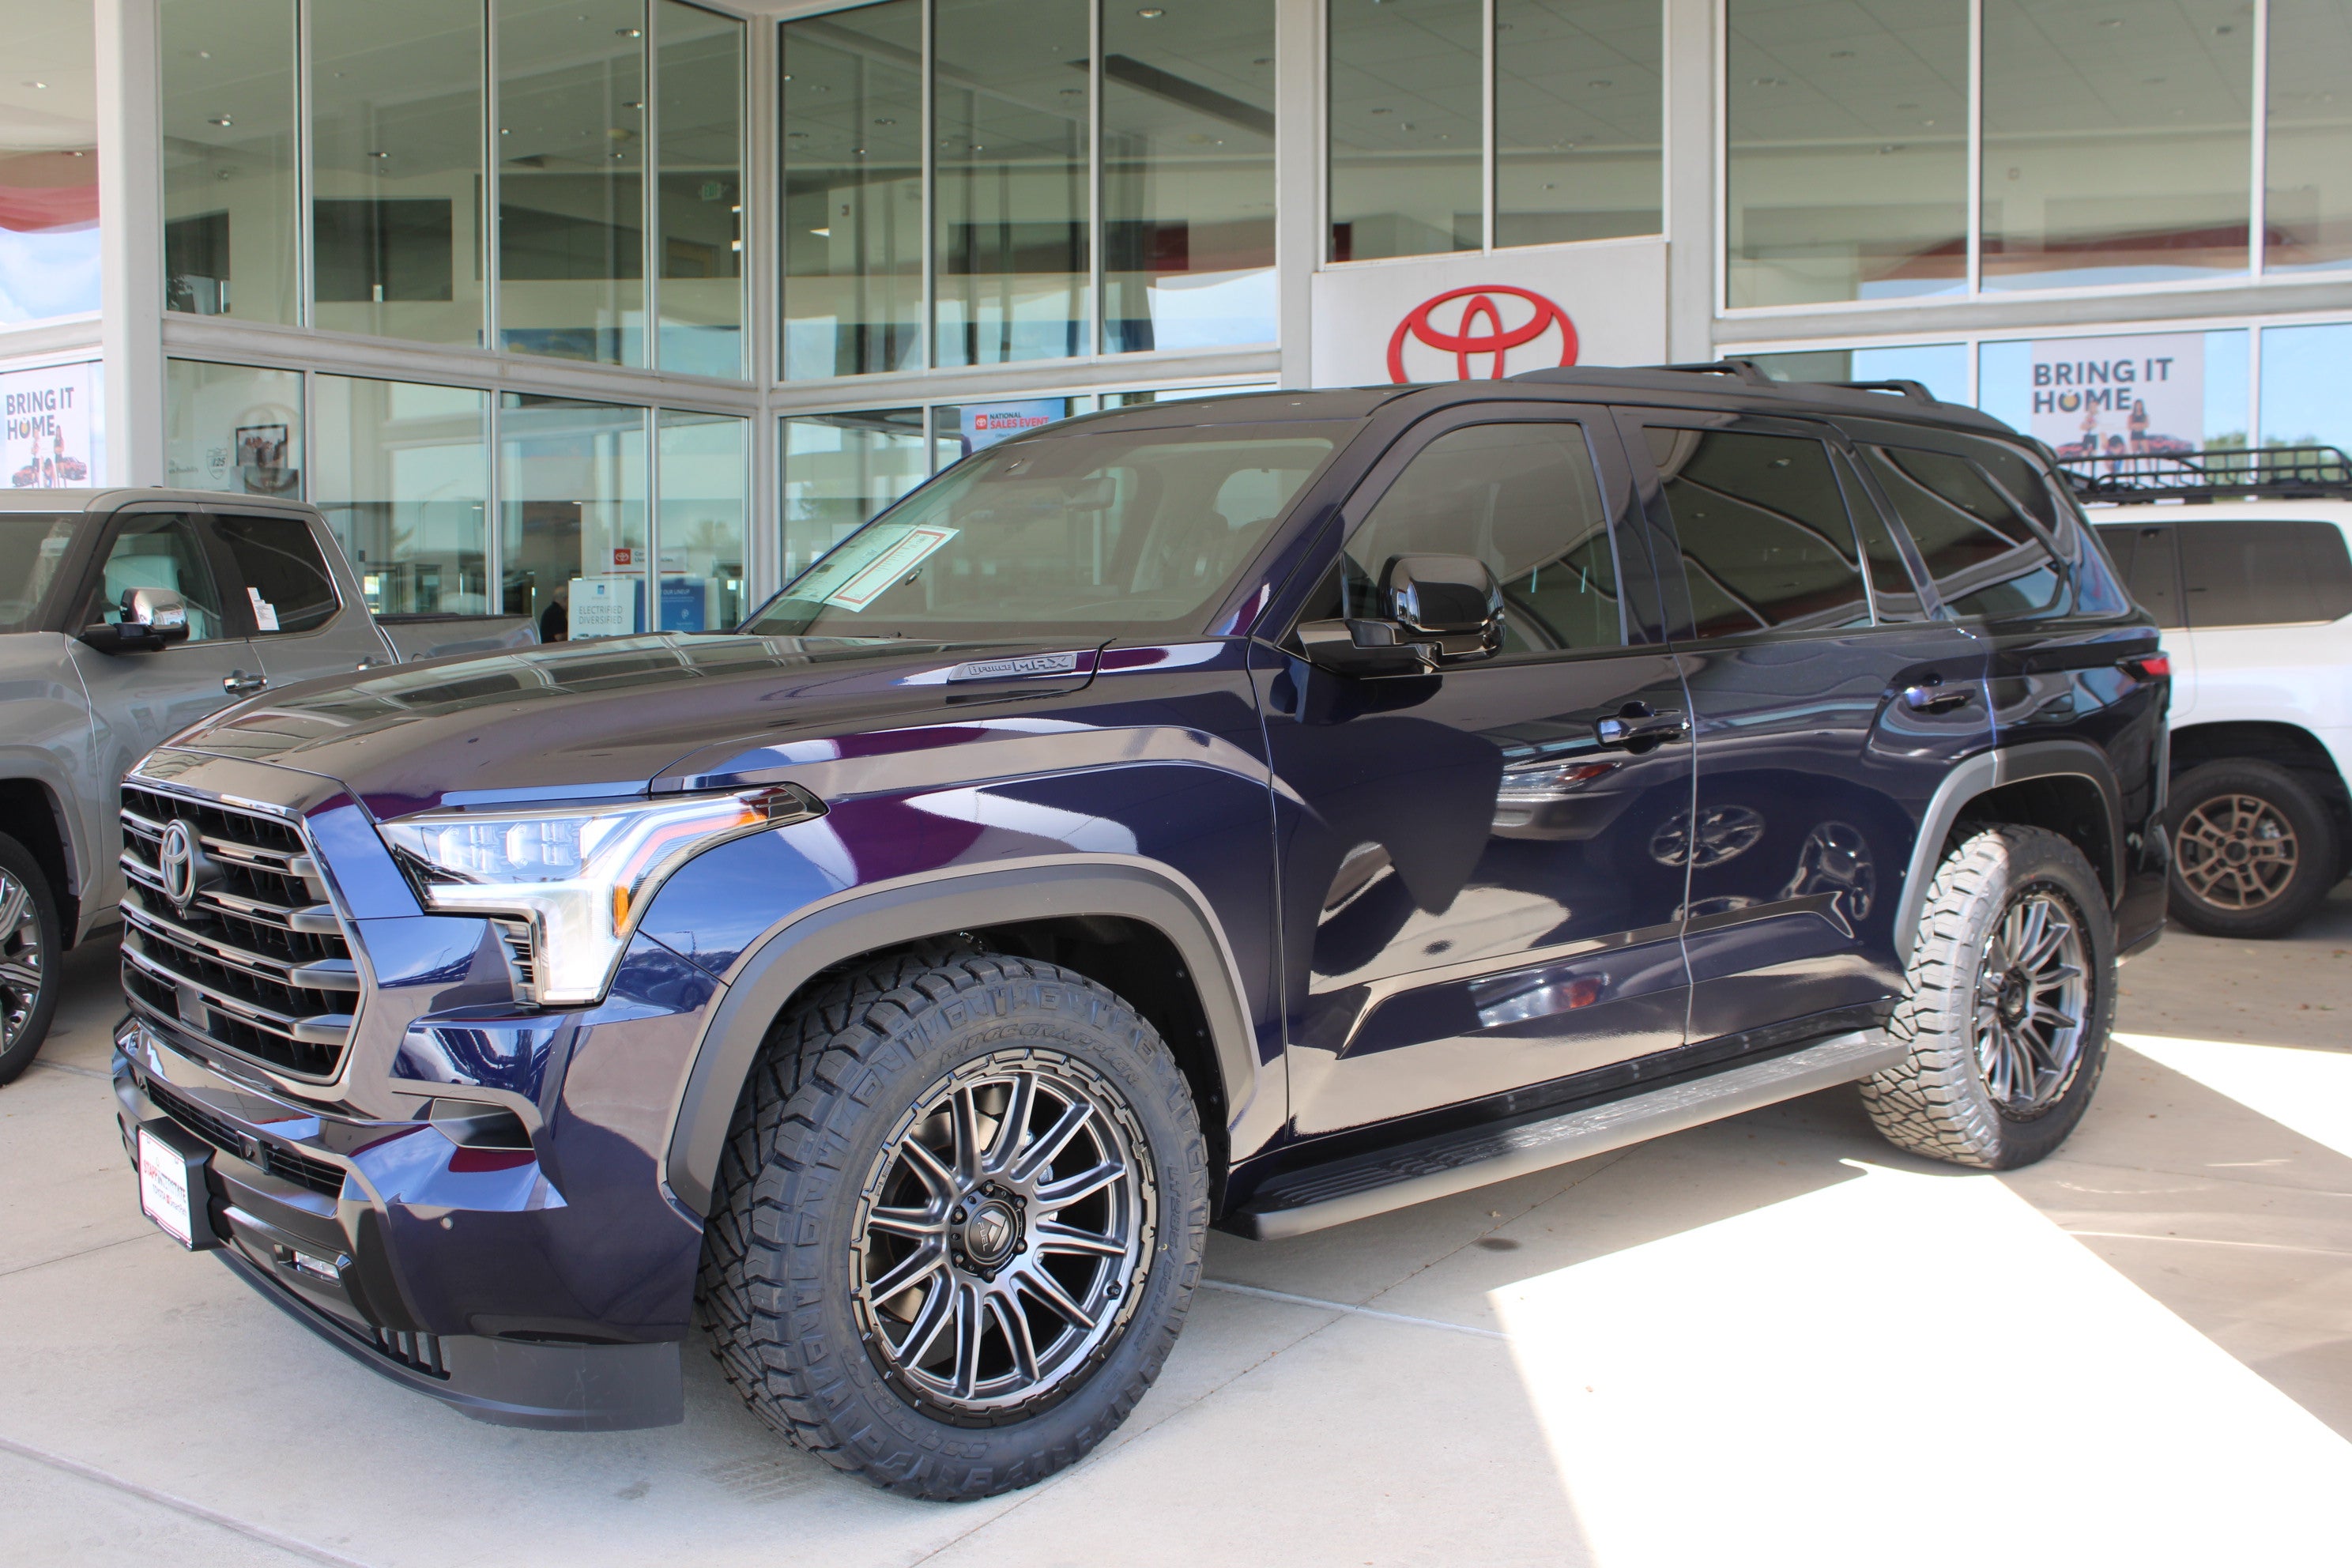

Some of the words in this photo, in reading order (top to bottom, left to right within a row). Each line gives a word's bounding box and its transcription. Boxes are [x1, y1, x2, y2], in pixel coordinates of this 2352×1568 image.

[2034, 360, 2135, 386] BRING
[2146, 358, 2173, 381] IT
[6, 390, 56, 415] BRING
[60, 387, 74, 409] IT
[2034, 388, 2132, 413] HOME
[7, 415, 55, 440] HOME
[990, 418, 1017, 429] SALES
[1020, 416, 1050, 427] EVENT
[579, 605, 623, 615] ELECTRIFIED
[579, 615, 623, 624] DIVERSIFIED
[1012, 657, 1069, 672] MAX
[977, 1221, 989, 1252] FUEL
